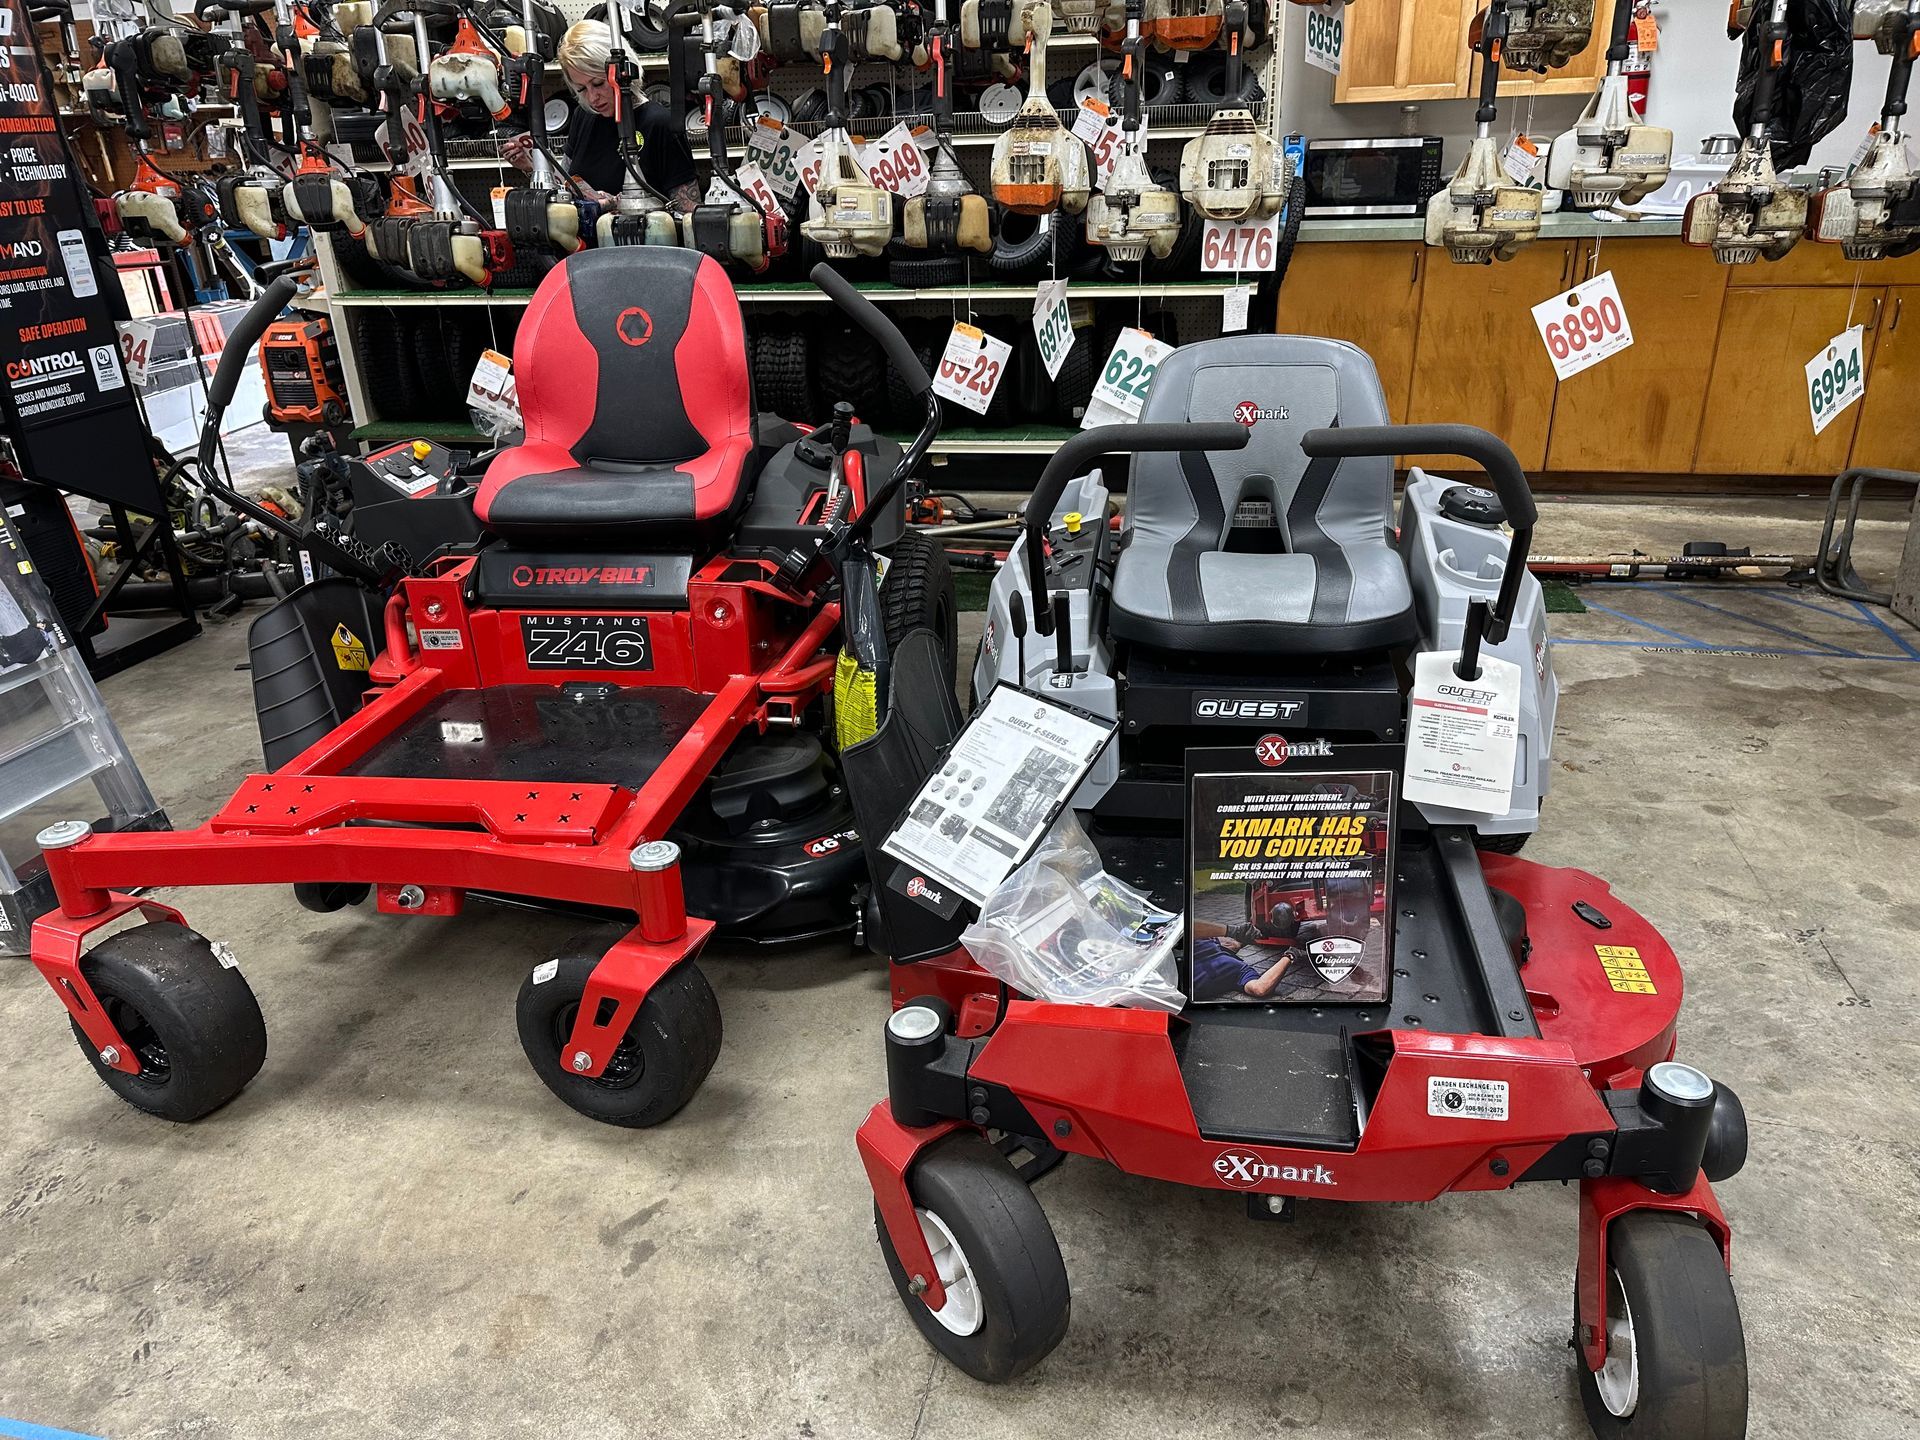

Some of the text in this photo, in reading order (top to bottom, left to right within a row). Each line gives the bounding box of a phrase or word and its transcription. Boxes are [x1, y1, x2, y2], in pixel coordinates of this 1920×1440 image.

[1308, 11, 1341, 57] 6859
[10, 148, 38, 163] PRICE
[11, 163, 67, 182] TECHNOLOGY
[870, 143, 922, 192] 6949
[14, 200, 28, 215] TO
[28, 199, 46, 214] USE
[1204, 228, 1272, 269] 6476
[26, 280, 38, 291] FUEL
[38, 278, 54, 290] LEVEL
[54, 276, 65, 287] AND
[19, 317, 87, 342] SAFE OPERATION
[1039, 299, 1068, 362] 6979
[1545, 296, 1621, 360] 6890
[6, 351, 83, 379] CONTROL
[1811, 347, 1860, 415] 6994
[14, 383, 72, 404] SENSES AND MANAGES
[1114, 390, 1128, 401] 6226
[18, 392, 86, 418] CARBON MONOXIDE OUTPUT
[1233, 405, 1290, 424] eXmark
[536, 567, 648, 584] TROY-BILT
[528, 630, 644, 666] Z46
[1438, 685, 1498, 701] QUEST
[1197, 699, 1304, 719] QUEST
[1493, 714, 1515, 722] KOHLER
[1008, 716, 1033, 730] QUEST
[1034, 727, 1069, 746] E-SERIES
[1256, 737, 1334, 763] eXmark
[1217, 805, 1245, 813] COMES
[1247, 804, 1293, 812] IMPORTANT
[1294, 803, 1352, 811] MAINTENANCE
[1244, 795, 1265, 803] WITH
[1291, 794, 1342, 802] INVESTMENT,
[1220, 817, 1366, 838] EXMARK HAS
[1219, 838, 1366, 858] YOU COVERED.
[1233, 863, 1249, 871] ASK
[1290, 862, 1304, 870] THE
[907, 879, 943, 905] eXmark
[1315, 955, 1356, 967] Original
[1433, 1080, 1457, 1088] GARDEN
[1213, 1154, 1337, 1185] eXmark
